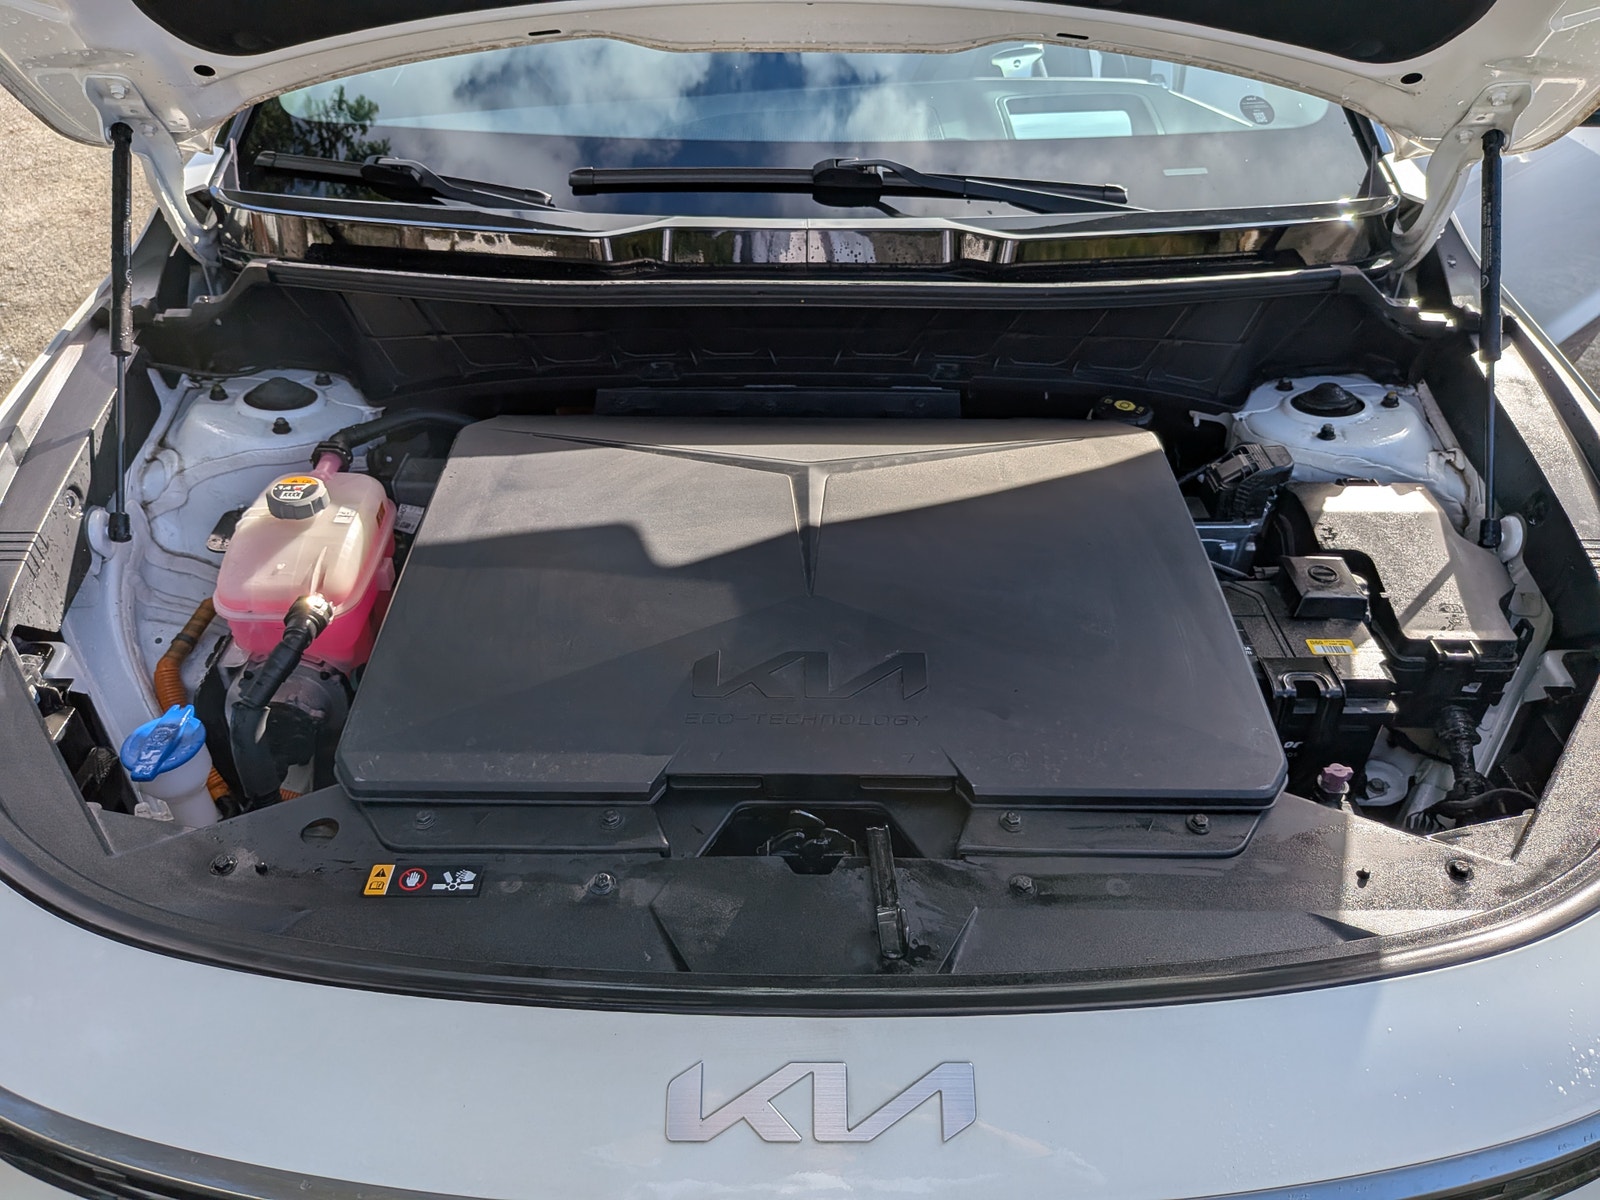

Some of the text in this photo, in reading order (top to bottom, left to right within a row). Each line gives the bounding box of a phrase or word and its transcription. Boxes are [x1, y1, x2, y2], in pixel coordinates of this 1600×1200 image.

[692, 650, 929, 700] KIA
[683, 712, 929, 727] ECO-TECHNOLOGY
[664, 1060, 978, 1143] KIA
